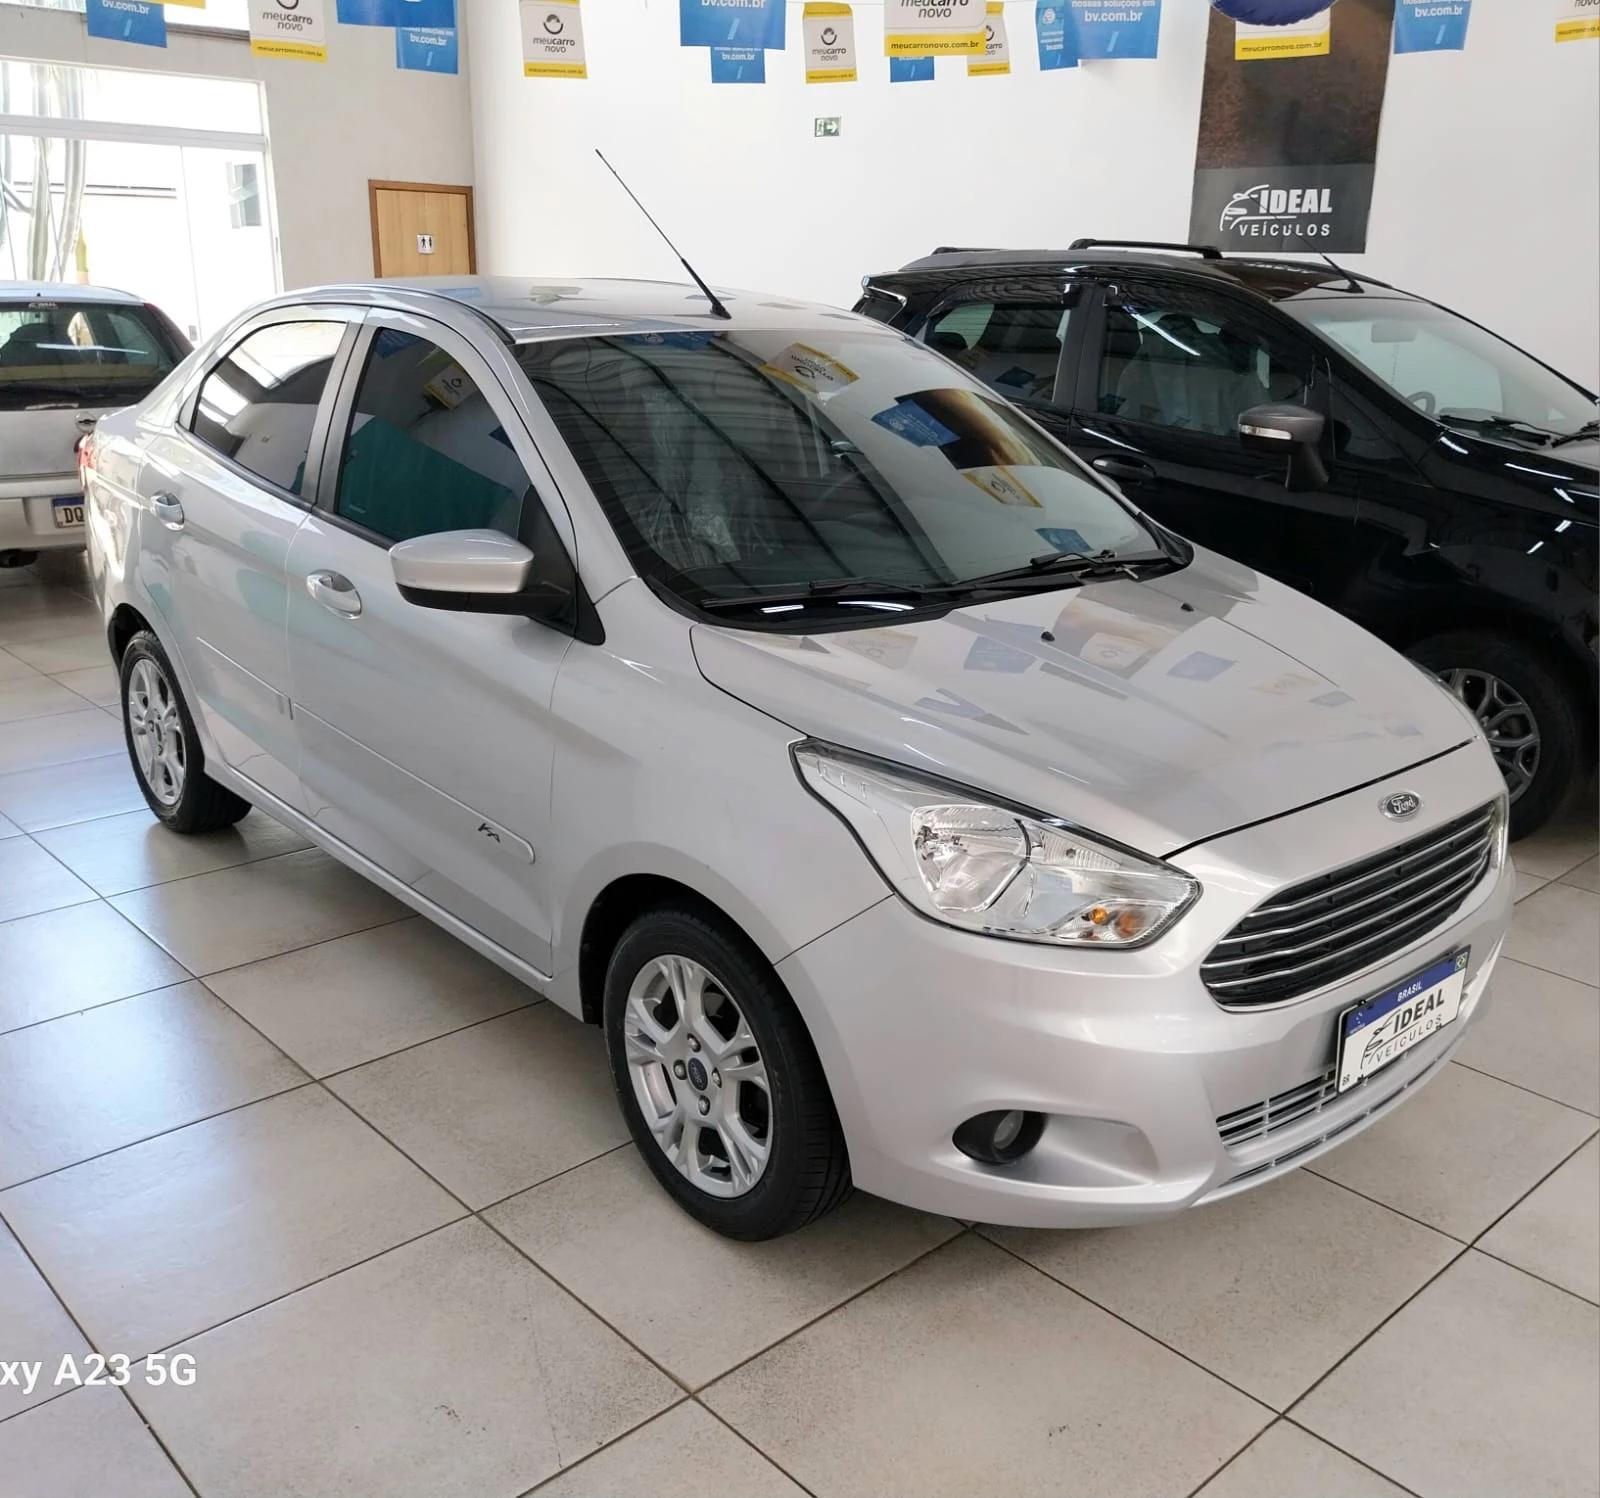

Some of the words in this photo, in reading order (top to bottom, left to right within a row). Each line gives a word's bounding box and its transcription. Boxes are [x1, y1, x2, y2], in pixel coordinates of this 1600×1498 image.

[918, 7, 952, 19] novo
[1084, 10, 1143, 22] bv.com.br
[1414, 5, 1463, 18] bv.com.br
[262, 12, 313, 25] meucarro
[277, 21, 303, 31] novo
[410, 32, 447, 46] bv.com.br
[533, 37, 576, 47] meucarro
[891, 40, 980, 50] meucarronovo.com.br
[544, 45, 567, 53] novo
[812, 48, 847, 56] meucarro
[722, 52, 755, 61] bv.com.br
[820, 54, 838, 62] novo
[1258, 188, 1333, 214] IDEAL
[1239, 221, 1331, 236] VEÍCULOS
[1390, 795, 1416, 814] Ford
[1397, 980, 1423, 1002] BRASIL
[1392, 988, 1445, 1035] IDEAL
